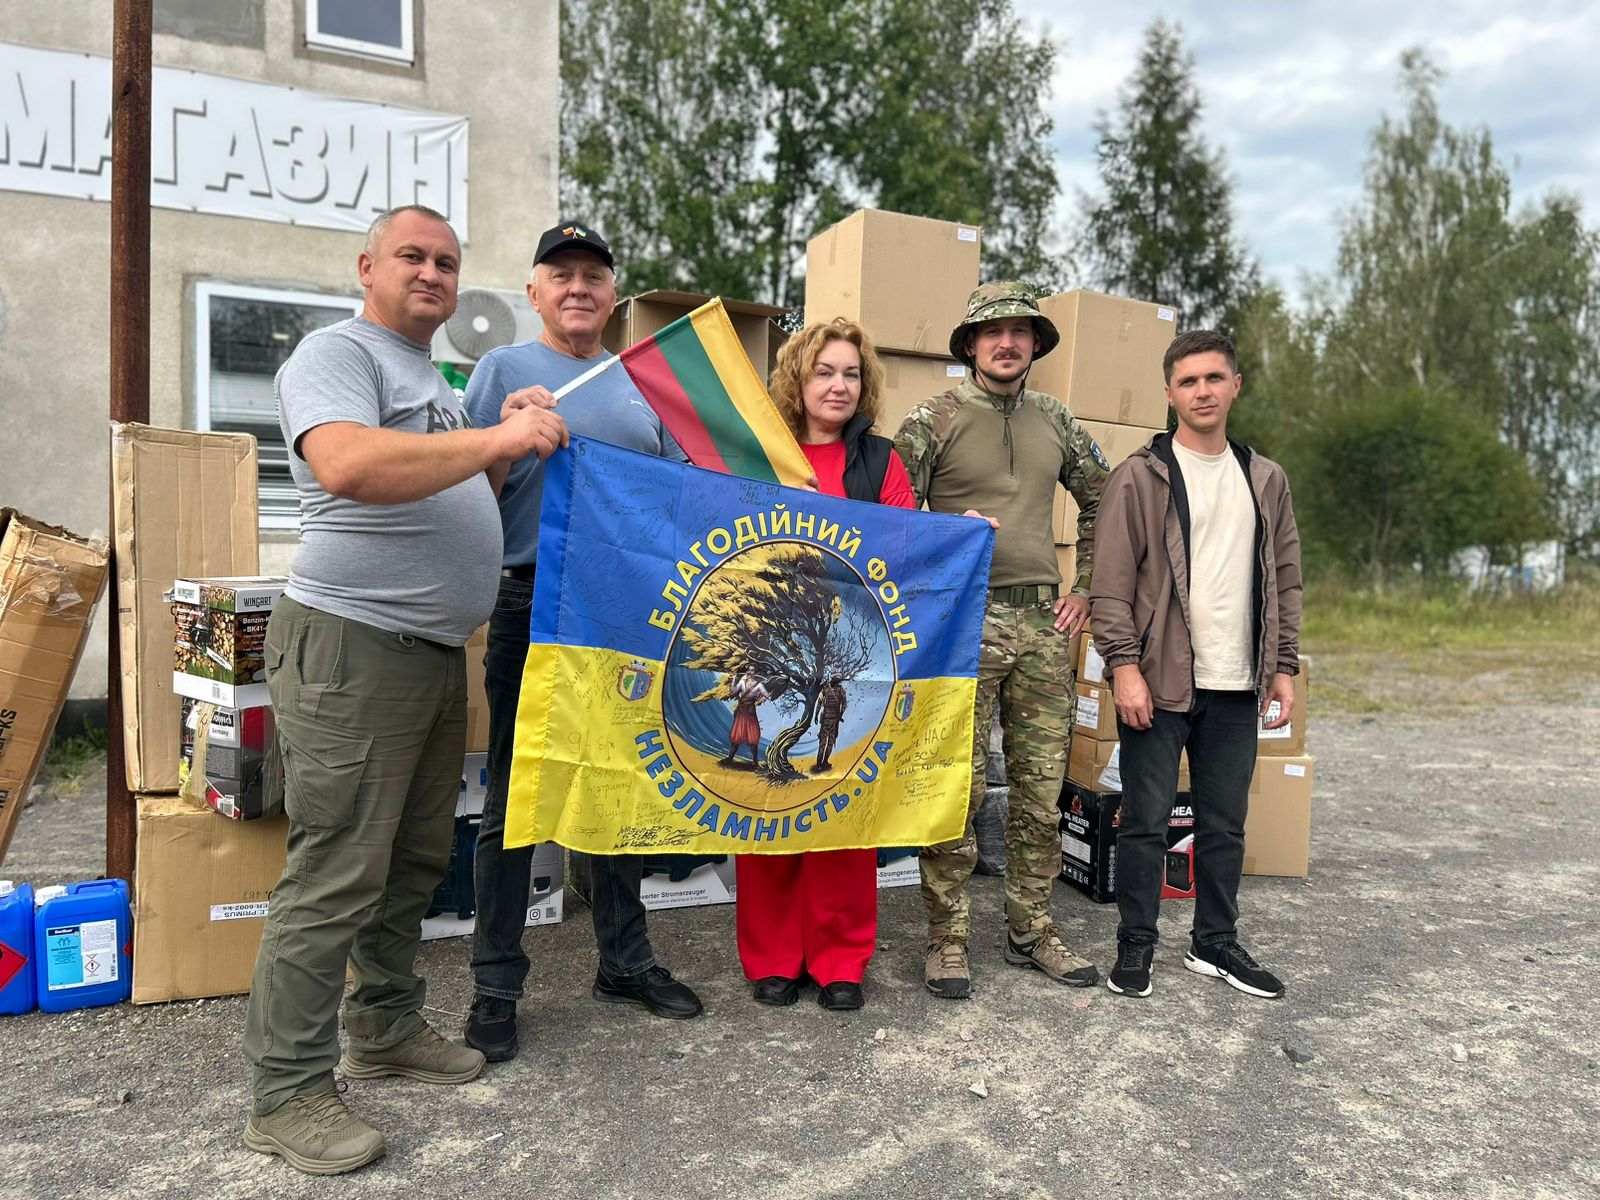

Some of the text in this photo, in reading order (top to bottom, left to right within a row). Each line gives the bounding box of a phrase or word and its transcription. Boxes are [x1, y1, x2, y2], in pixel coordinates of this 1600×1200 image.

[648, 503, 918, 656] БЛАГОДІЙНИЙ ФОНД
[1171, 806, 1193, 816] HEA
